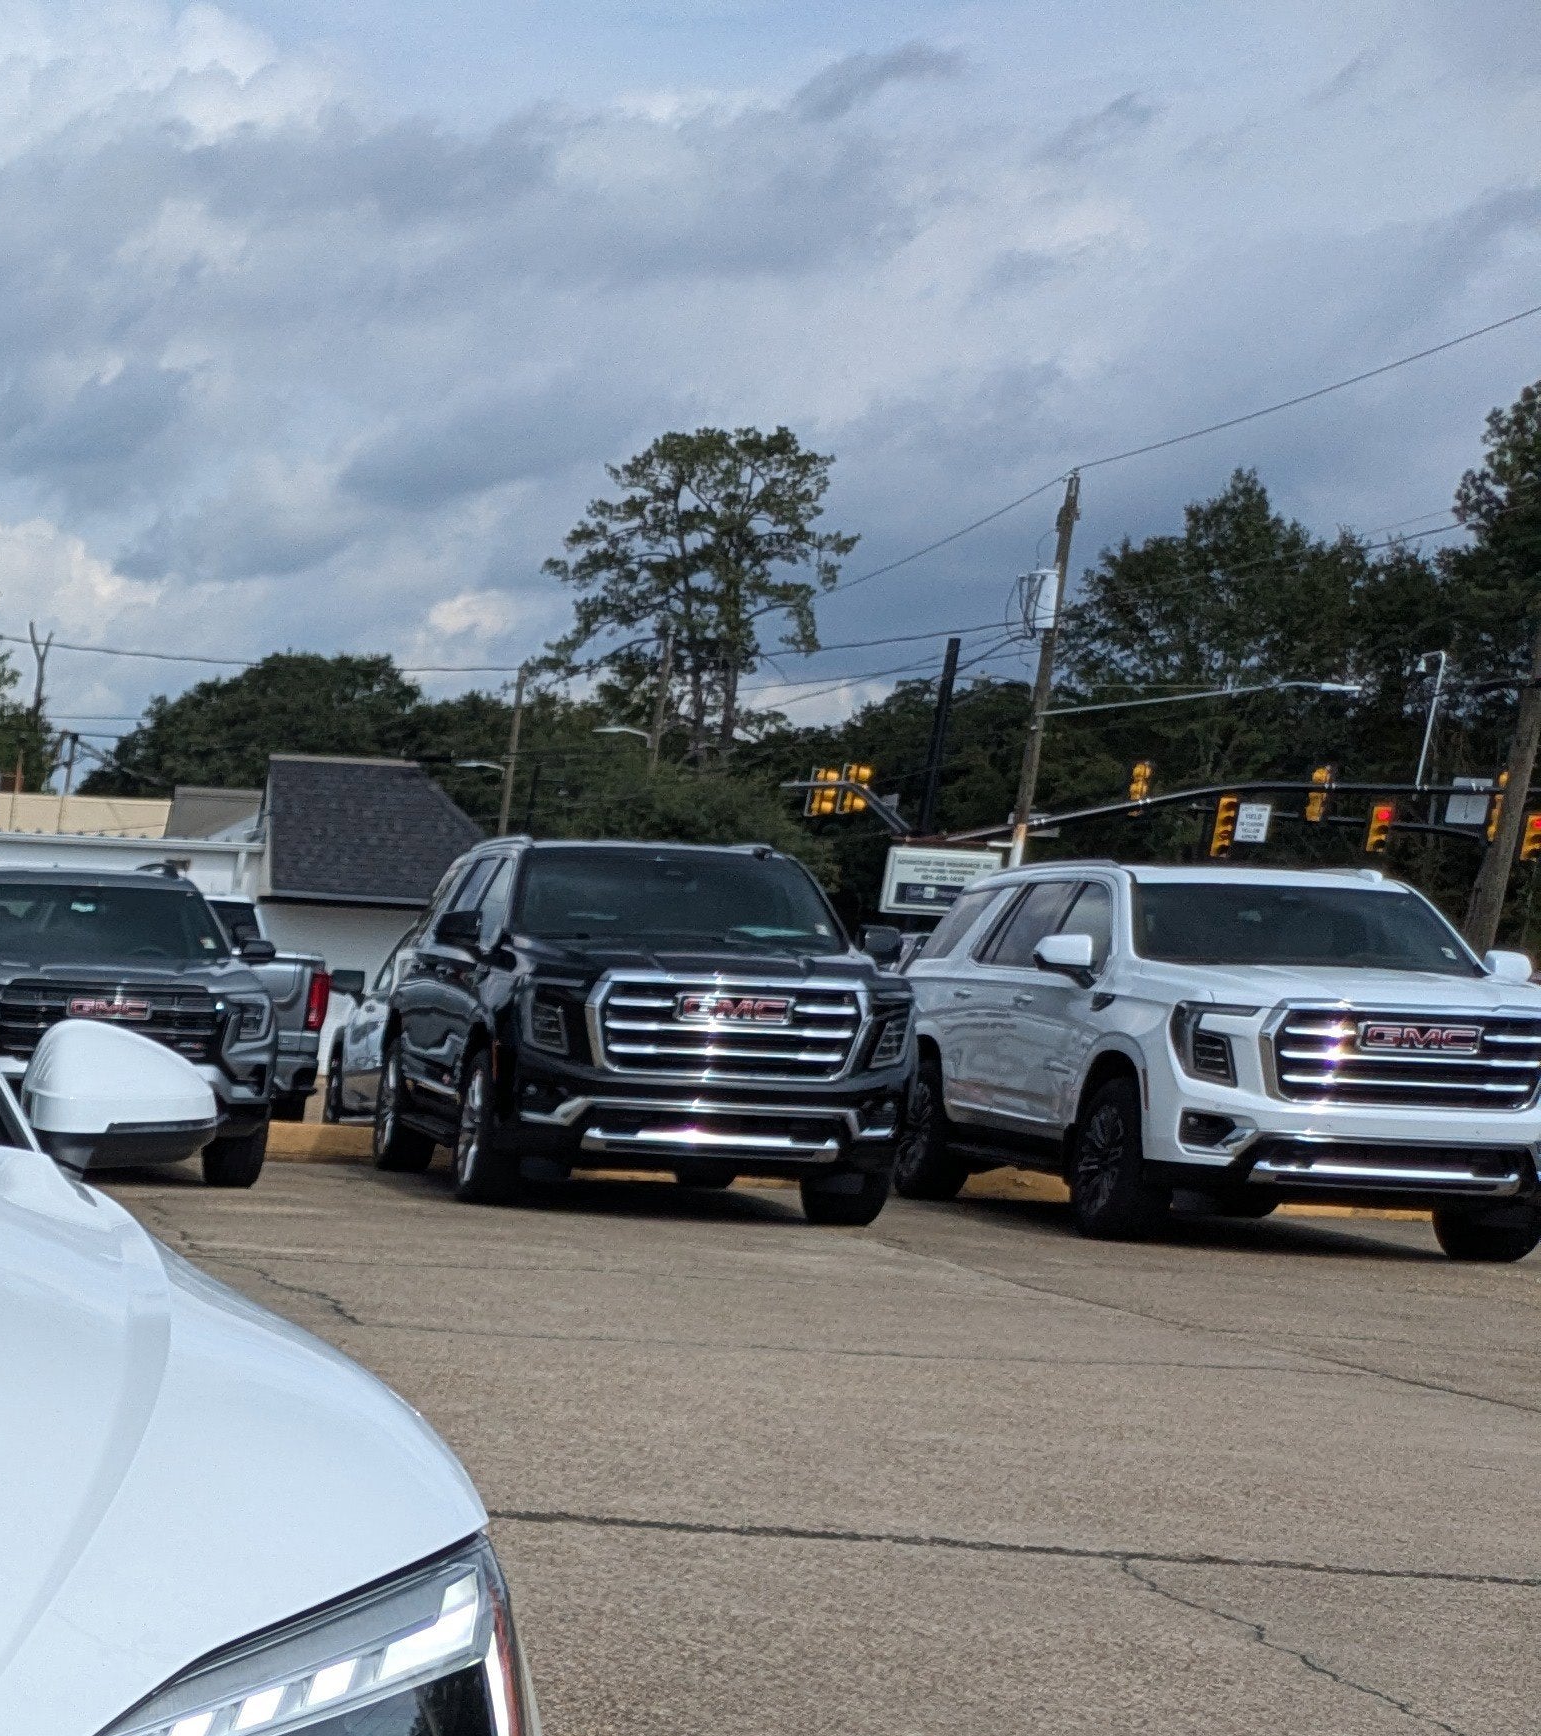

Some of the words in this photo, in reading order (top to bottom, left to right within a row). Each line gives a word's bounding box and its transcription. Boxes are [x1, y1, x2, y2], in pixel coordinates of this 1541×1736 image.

[69, 997, 148, 1018] GMC
[682, 997, 789, 1021] GMC
[1365, 1025, 1478, 1051] GMC
